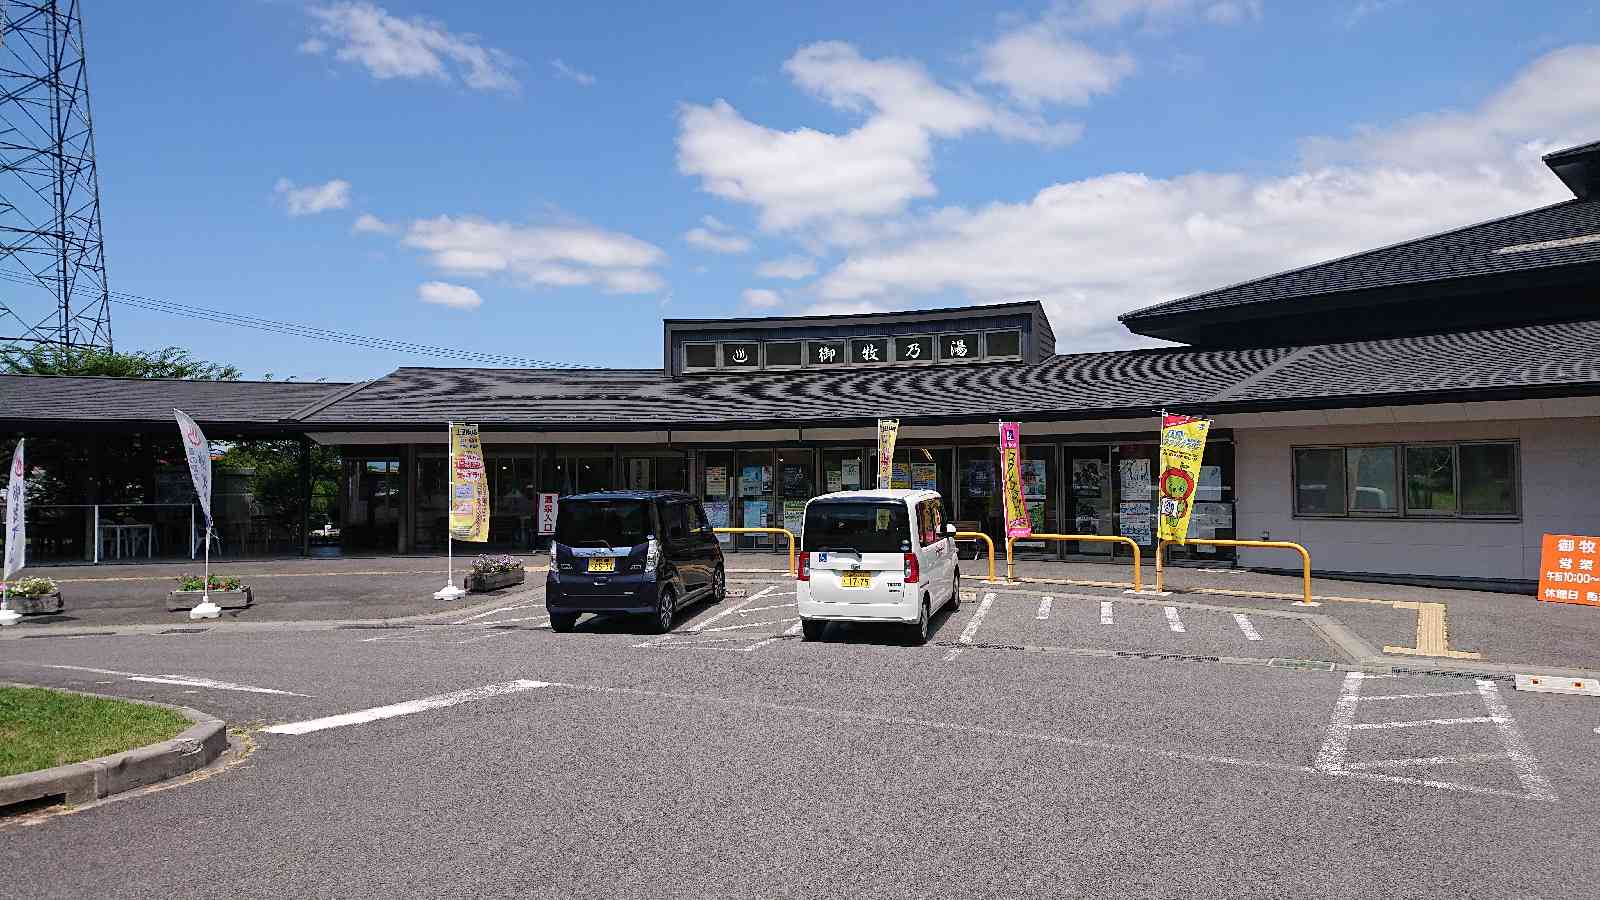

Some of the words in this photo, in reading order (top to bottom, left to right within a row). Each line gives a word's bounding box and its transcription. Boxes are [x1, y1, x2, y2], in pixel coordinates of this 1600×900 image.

[818, 340, 968, 362] 御牧乃湯
[543, 495, 553, 531] 温泉入口
[1557, 539, 1597, 554] 御牧
[1559, 557, 1593, 571] 営業
